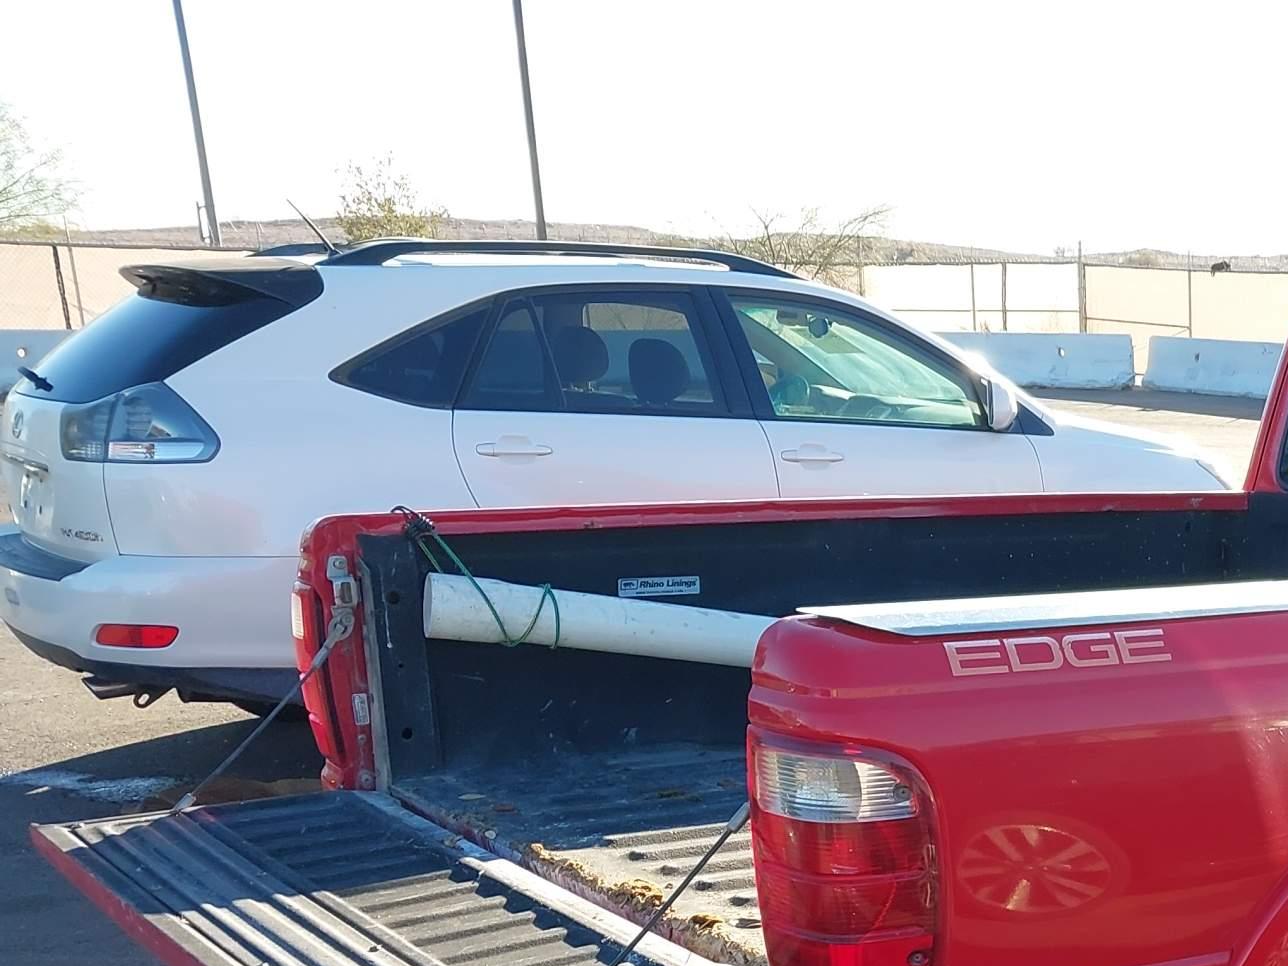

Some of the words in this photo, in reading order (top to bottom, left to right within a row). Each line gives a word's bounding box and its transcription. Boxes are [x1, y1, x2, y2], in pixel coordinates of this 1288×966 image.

[640, 580, 664, 589] Rhino
[667, 578, 698, 588] Linings
[943, 628, 1172, 677] EDGE
